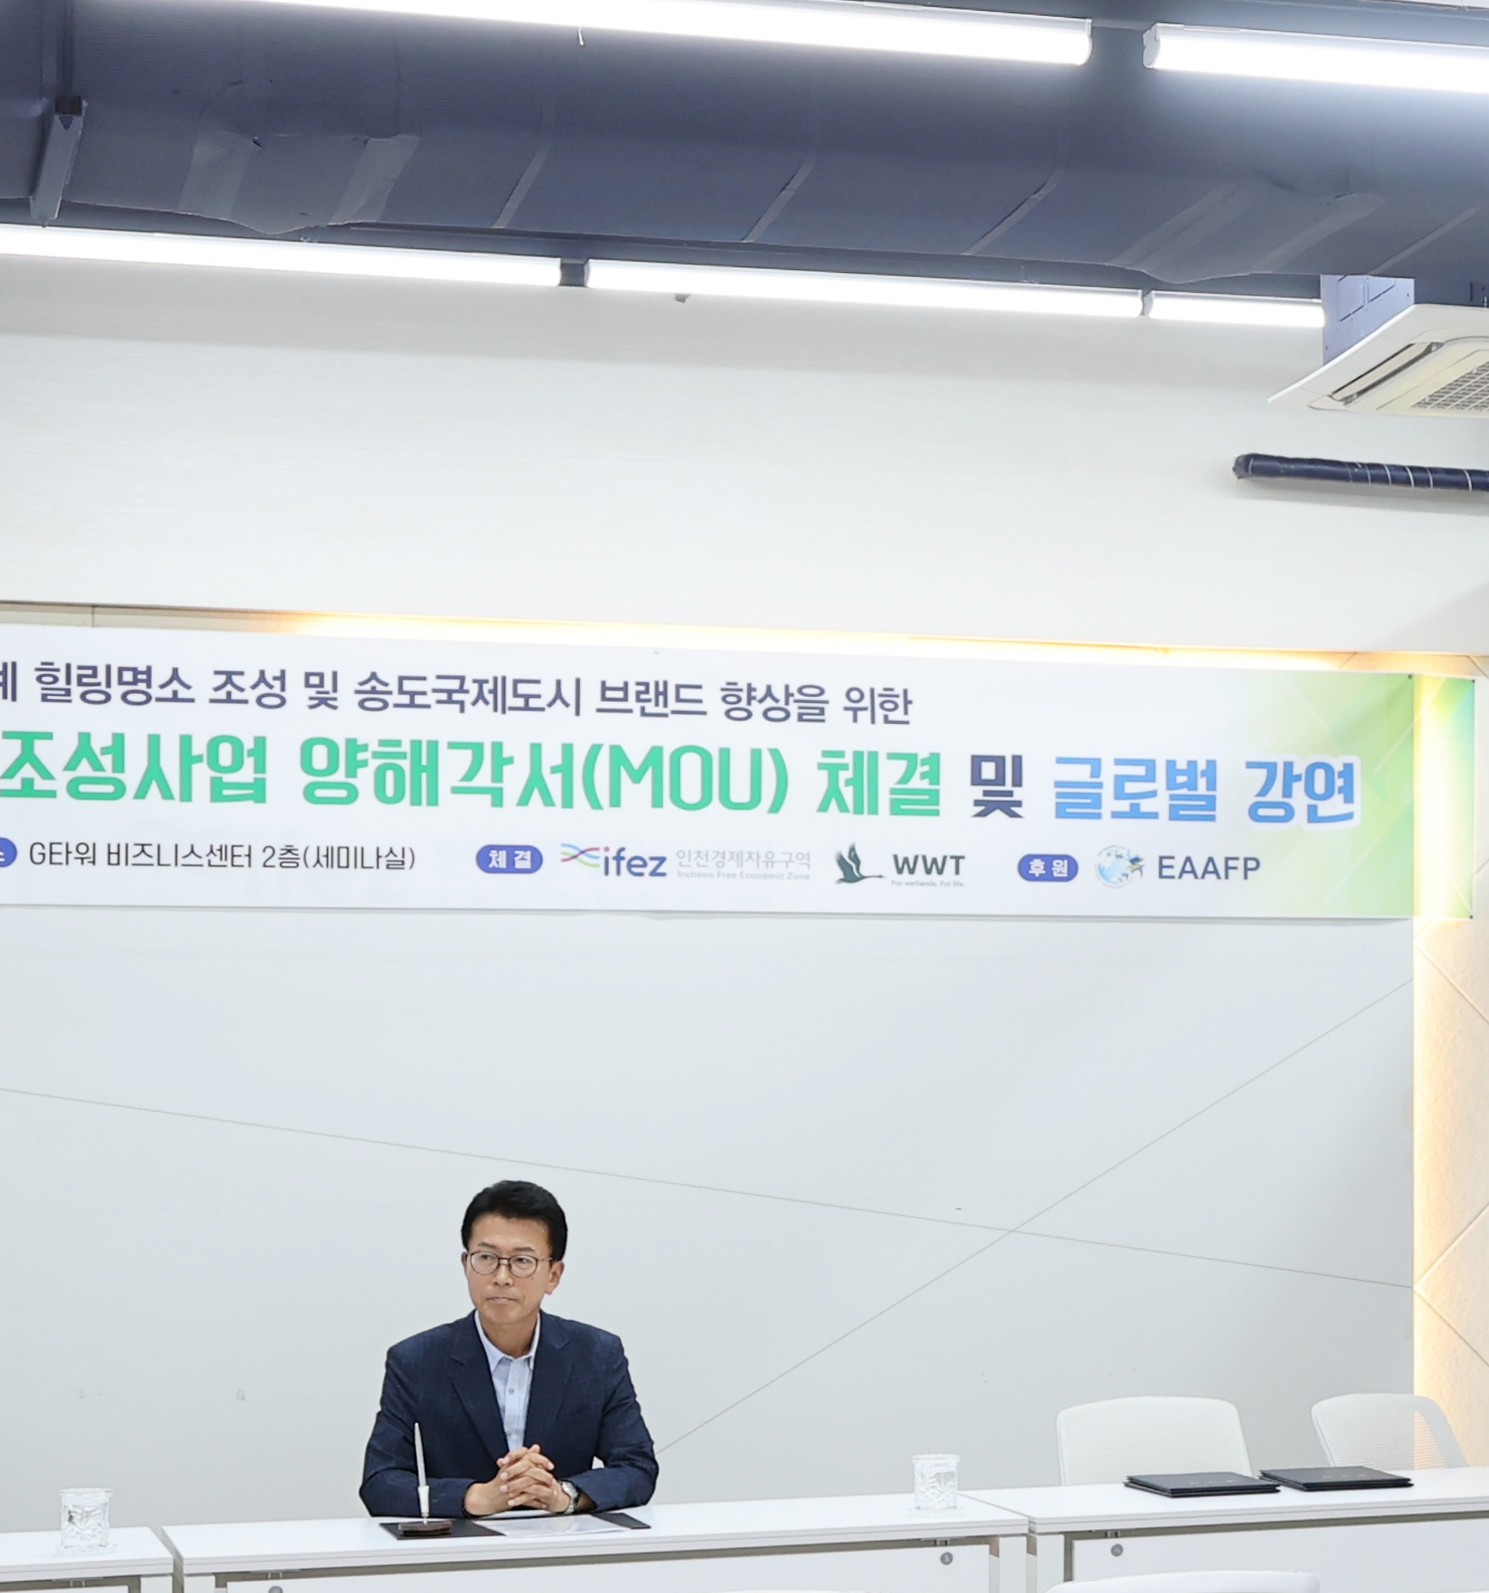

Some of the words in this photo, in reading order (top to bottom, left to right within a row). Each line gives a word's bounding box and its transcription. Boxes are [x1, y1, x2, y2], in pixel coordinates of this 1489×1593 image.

[34, 661, 196, 707] 힐링명소
[209, 668, 287, 711] 조성
[304, 670, 339, 711] 및
[354, 671, 581, 718] 송도국제도시
[596, 679, 708, 719] 브랜드
[720, 681, 830, 725] 향상을
[843, 686, 914, 726] 위한
[299, 736, 789, 815] 양해각서(MOU)
[816, 749, 942, 818] 체결
[970, 754, 1024, 819] 및
[1053, 756, 1218, 823] 글로벌
[1246, 760, 1355, 824] 강연
[29, 841, 97, 867] G타워
[107, 842, 252, 868] 비즈니스센터
[262, 844, 416, 871] 2층(세미나실)
[604, 846, 667, 877] ifez
[676, 849, 811, 870] 인천경제자유구역
[893, 854, 965, 876] WWT
[1158, 855, 1261, 880] EAAFP
[677, 869, 715, 879] Incheon
[717, 870, 738, 880] Free
[739, 871, 785, 881] Economic
[786, 872, 811, 881] Zone
